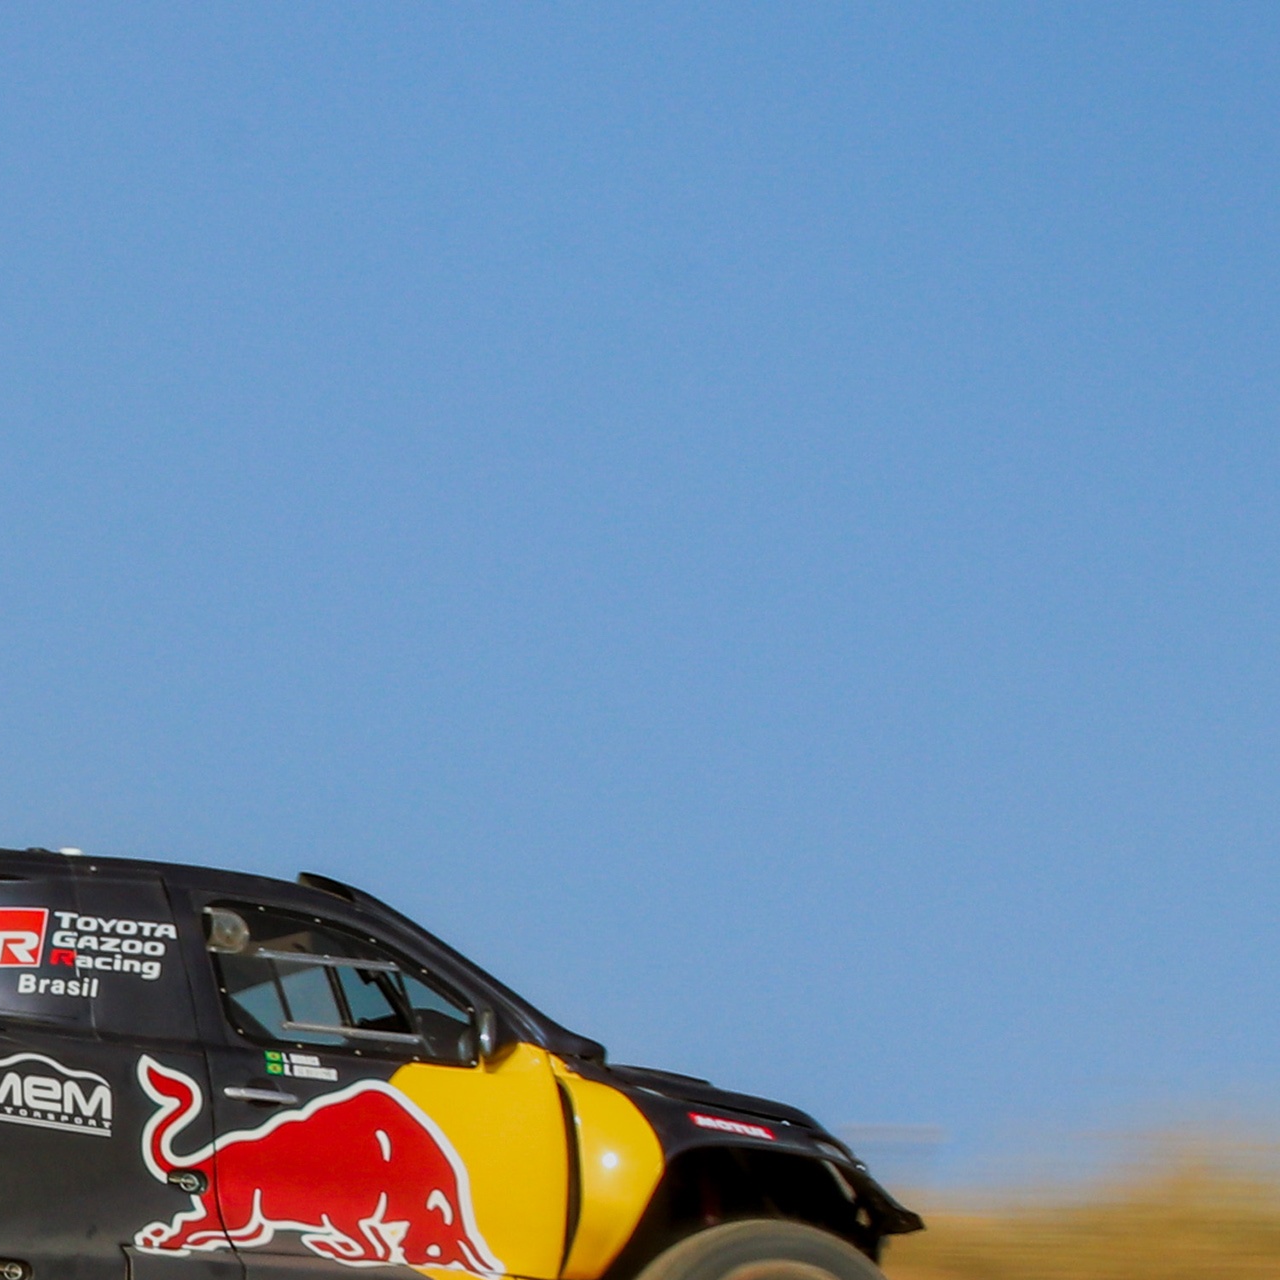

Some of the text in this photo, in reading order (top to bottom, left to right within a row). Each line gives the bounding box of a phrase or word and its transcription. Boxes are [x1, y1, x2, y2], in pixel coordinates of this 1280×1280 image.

[53, 911, 178, 939] TOYOTA
[52, 930, 166, 957] GAZOO
[49, 948, 161, 980] Racing
[17, 973, 100, 998] Brasil
